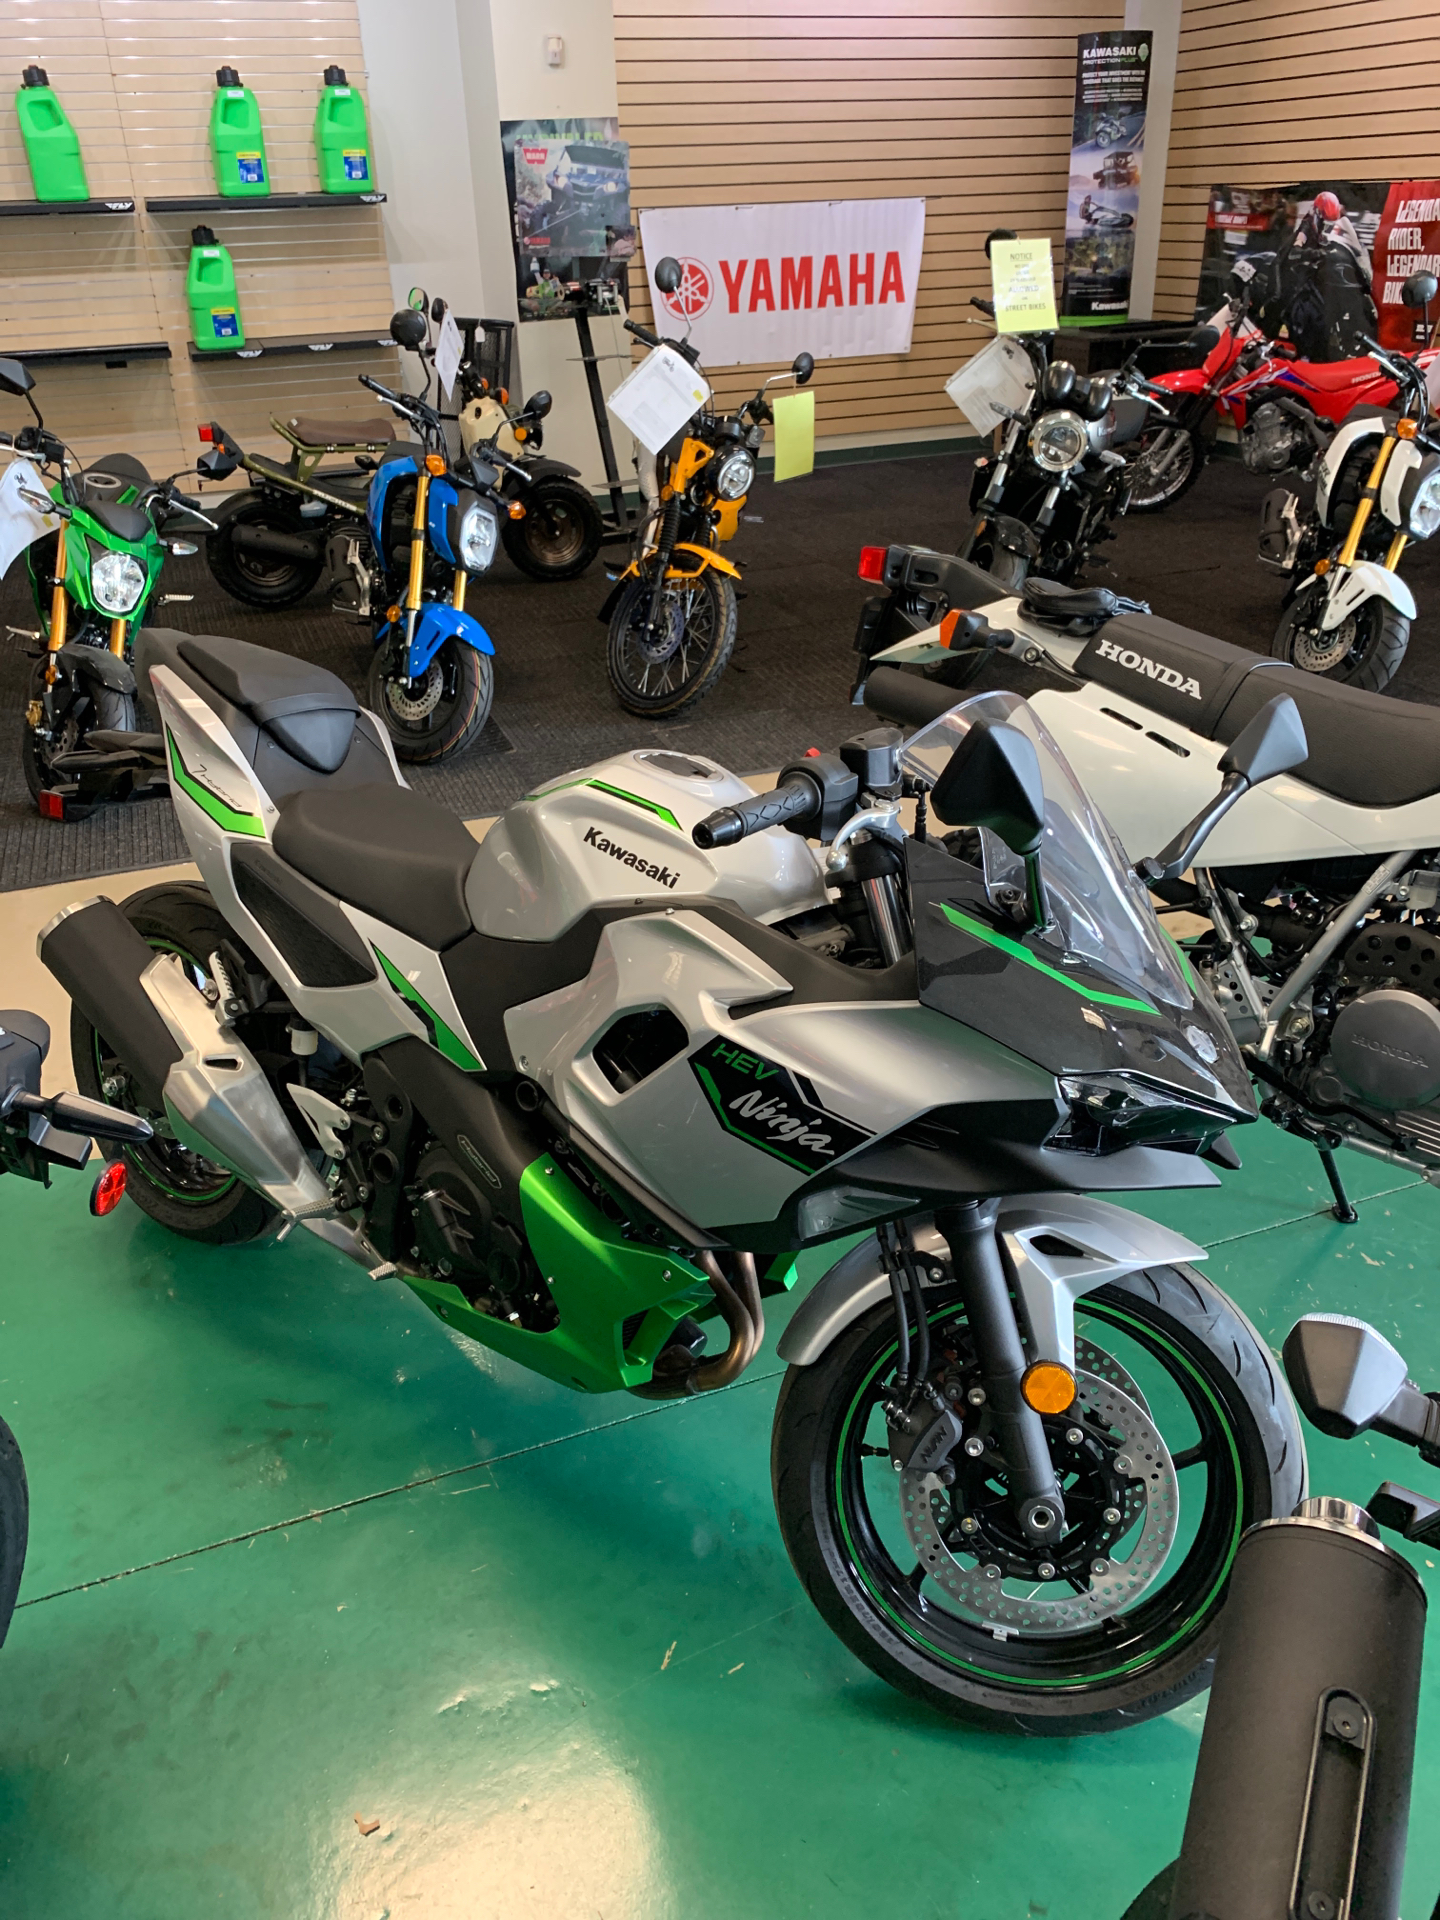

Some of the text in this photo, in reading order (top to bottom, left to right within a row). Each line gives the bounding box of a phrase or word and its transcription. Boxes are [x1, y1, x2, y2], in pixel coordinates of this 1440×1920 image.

[1083, 46, 1137, 59] KAWASAKI
[1388, 227, 1425, 252] RIDER,
[1010, 252, 1033, 261] NOTICE
[719, 250, 906, 314] YAMAHA
[1383, 281, 1405, 304] BIK
[1005, 304, 1027, 312] STREET
[1091, 301, 1128, 311] Kawasak
[1095, 637, 1203, 700] HONDA
[582, 825, 682, 889] Kawasaki
[711, 1042, 780, 1080] HEV
[1350, 1033, 1430, 1069] HONDA
[728, 1089, 836, 1156] Ninja
